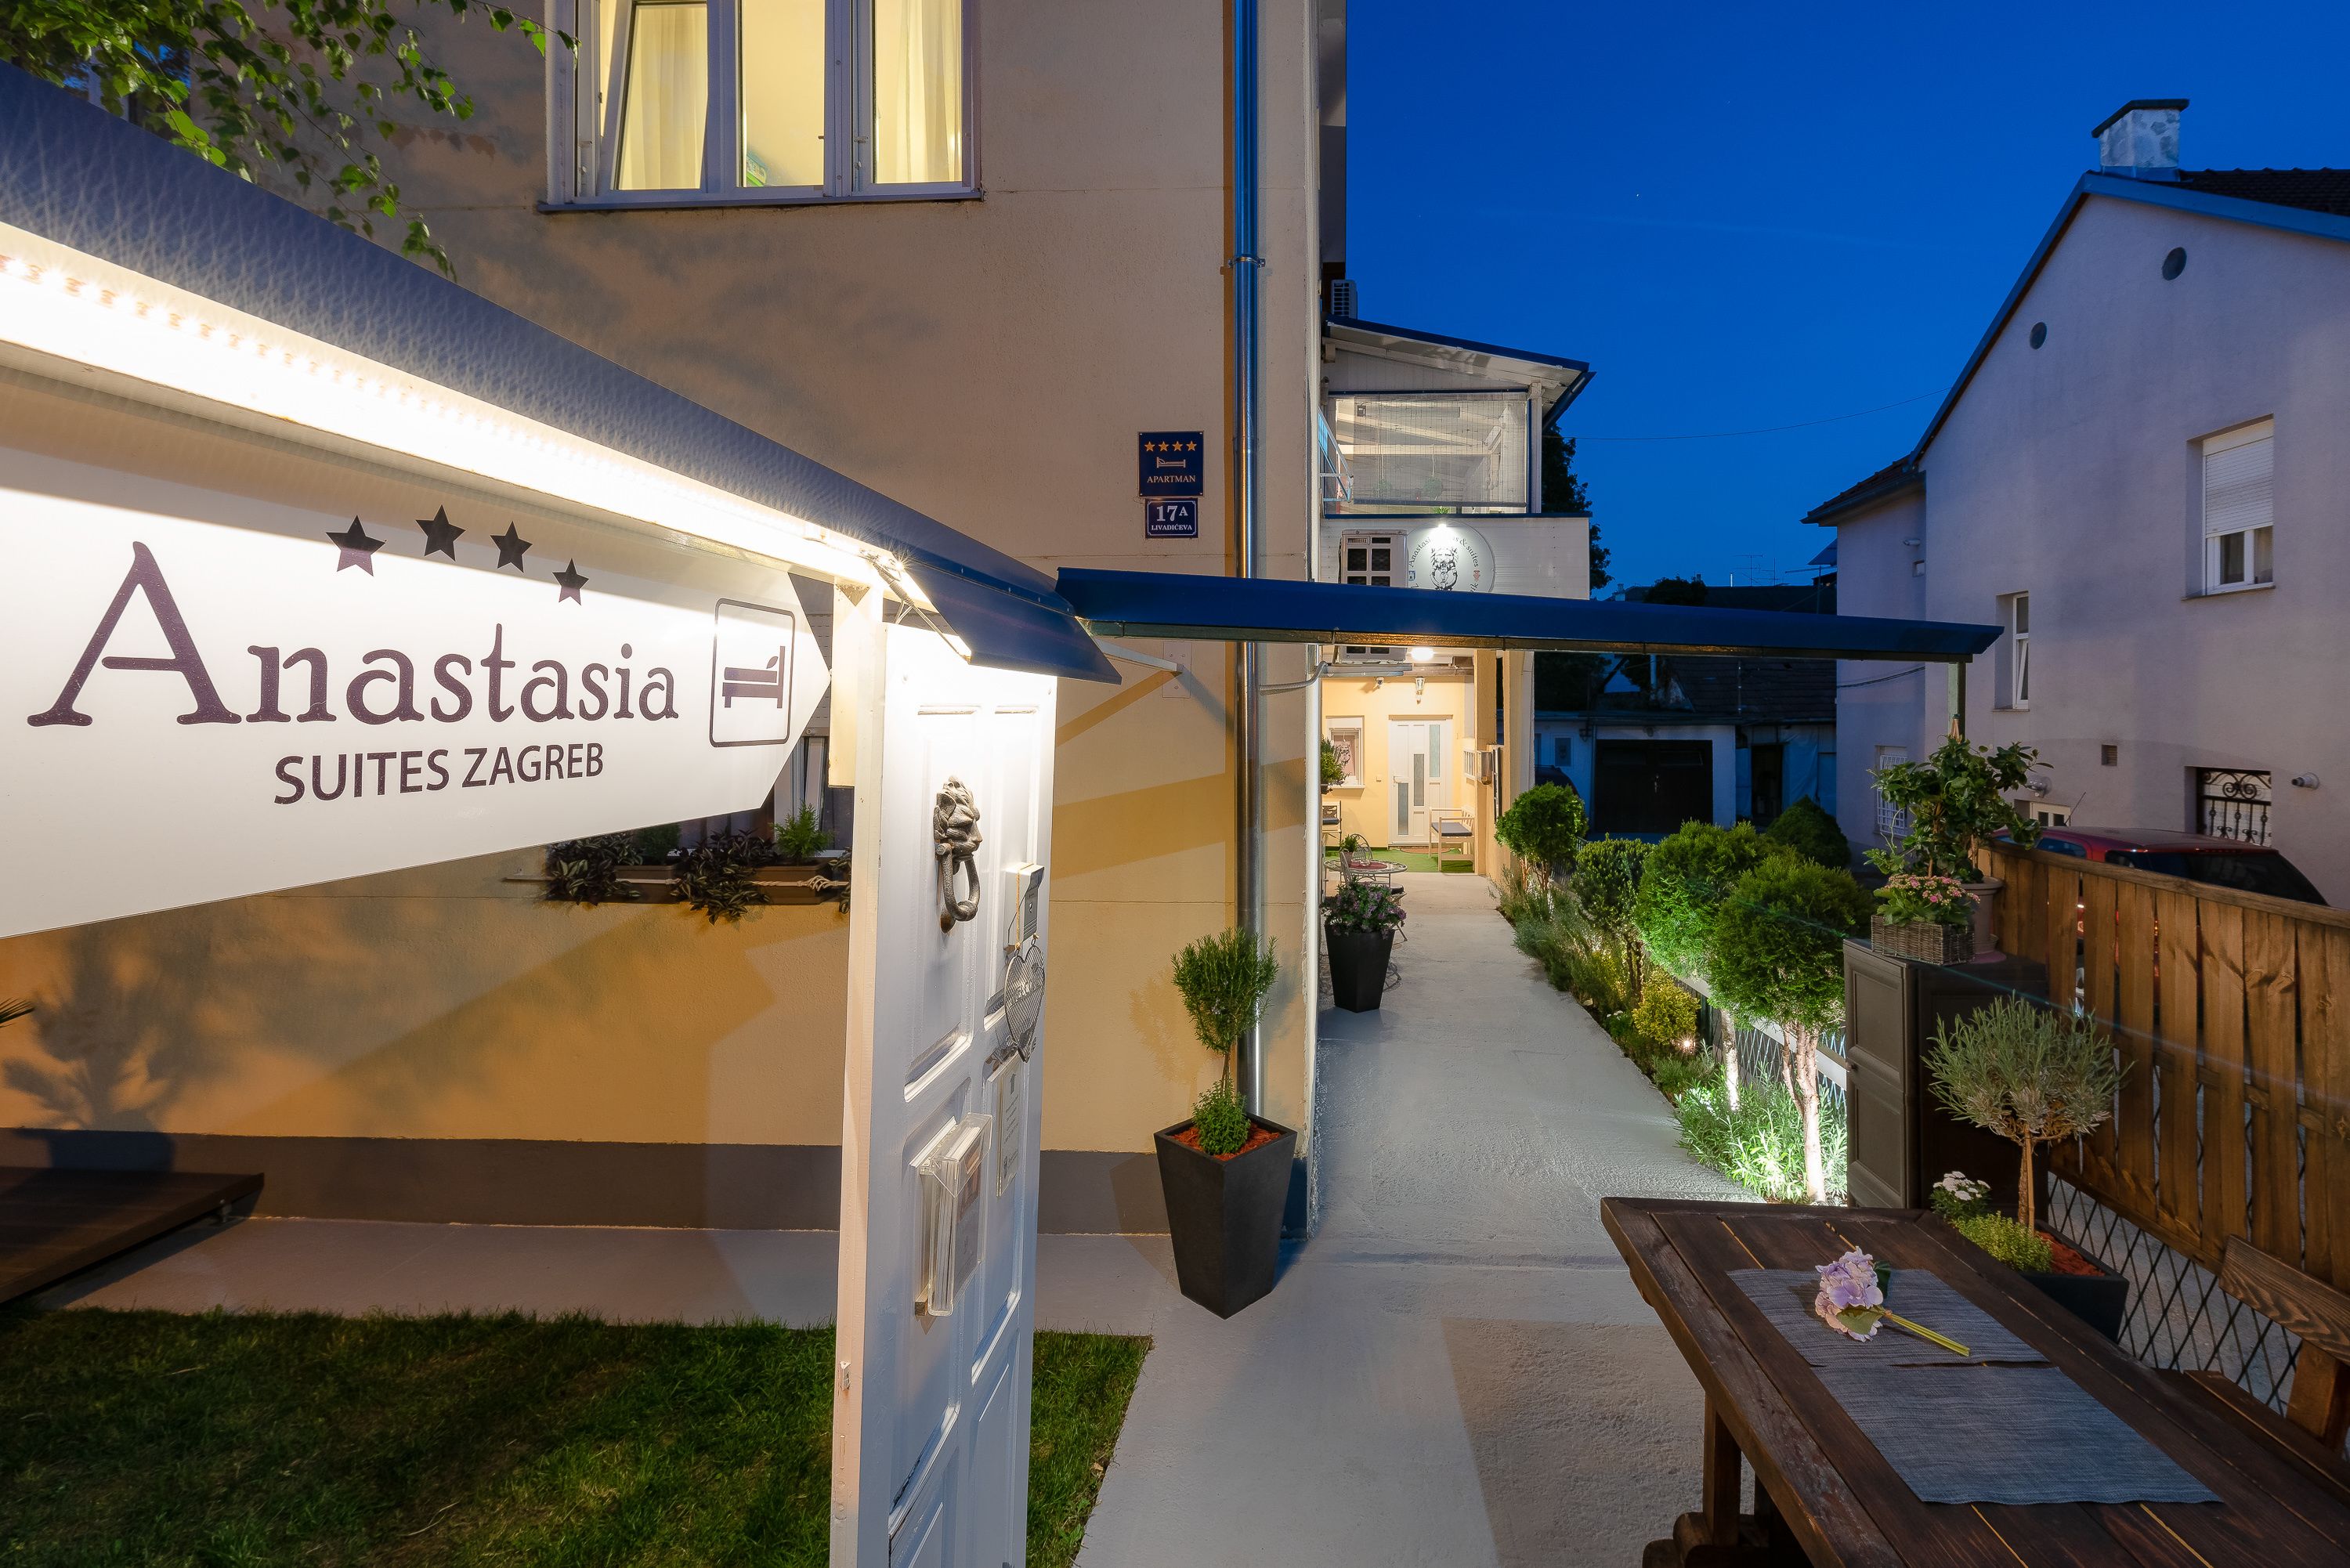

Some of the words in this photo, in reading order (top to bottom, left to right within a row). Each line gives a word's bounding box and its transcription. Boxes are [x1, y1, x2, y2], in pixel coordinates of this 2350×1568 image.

[1156, 505, 1188, 522] 17A
[1466, 545, 1479, 568] suites
[27, 540, 679, 727] Anastasia
[274, 749, 450, 804] SUITES
[461, 742, 604, 788] ZAGREB
